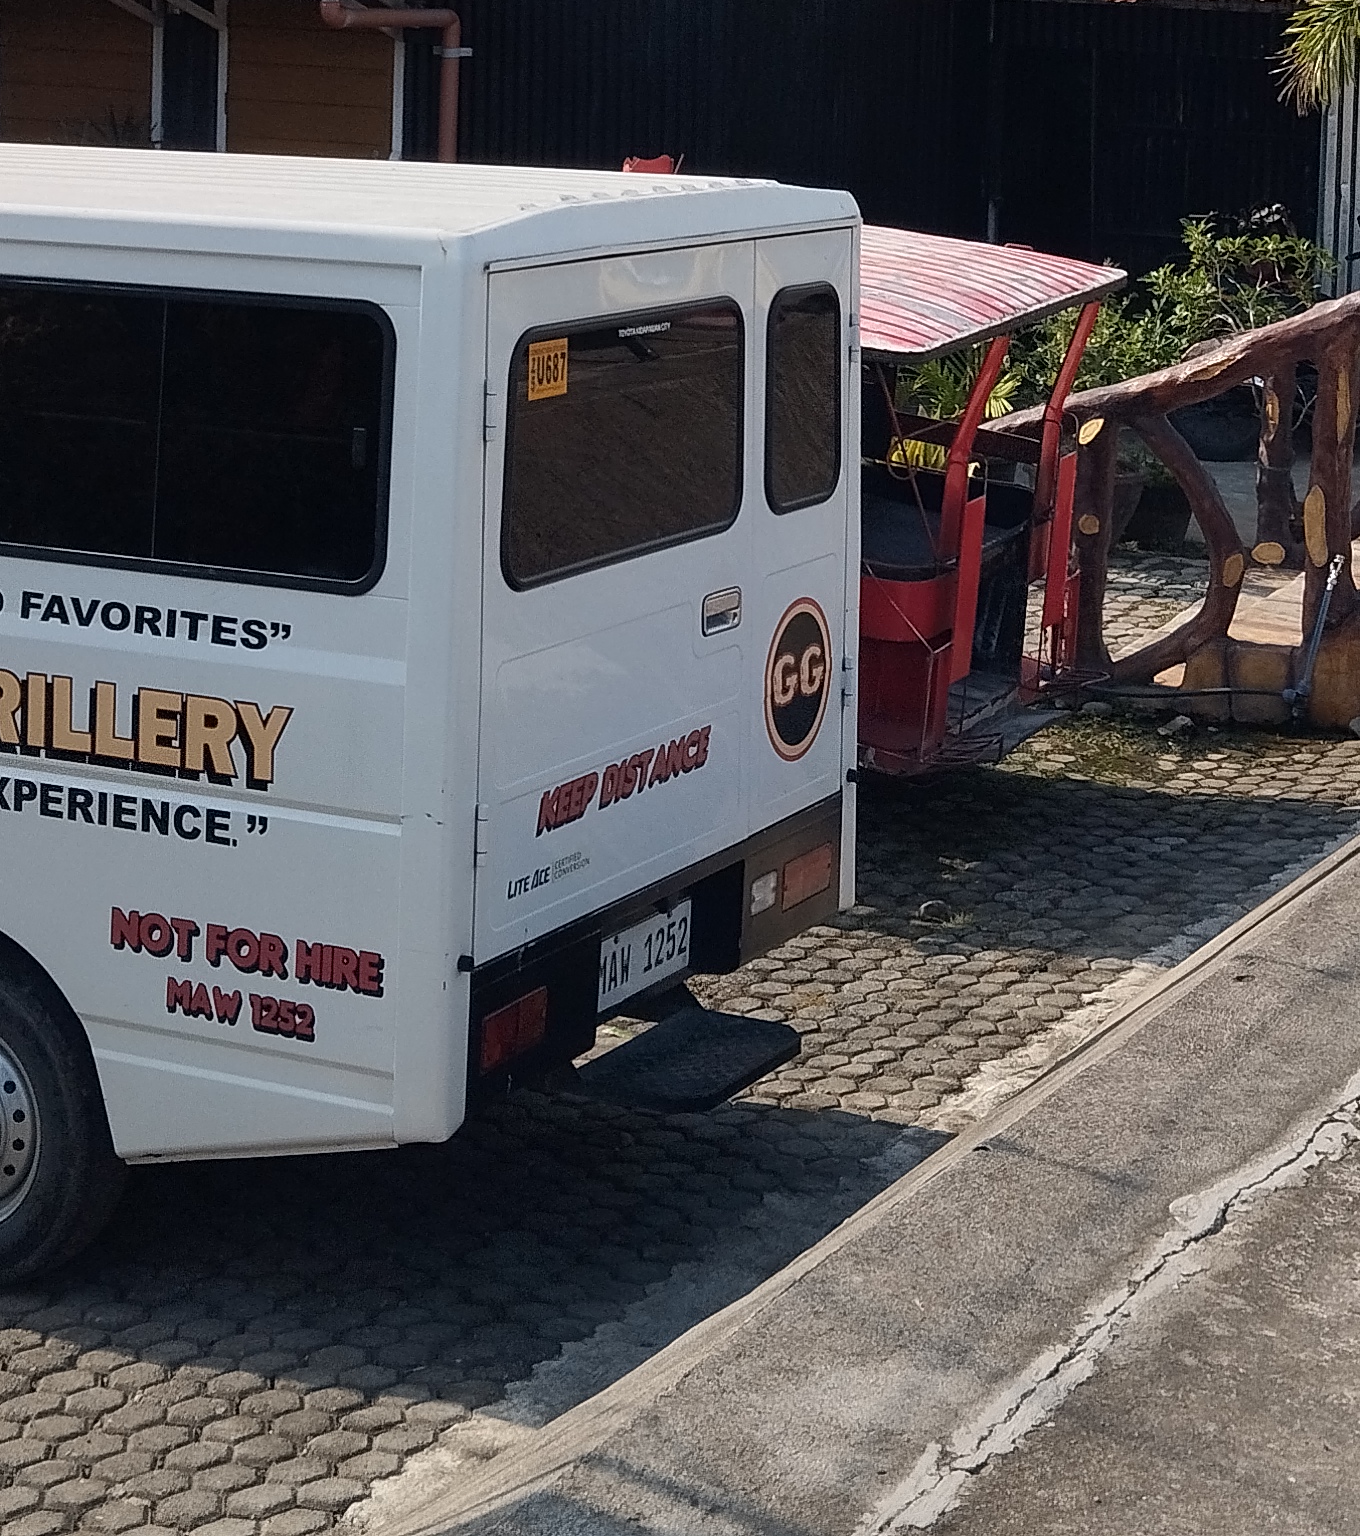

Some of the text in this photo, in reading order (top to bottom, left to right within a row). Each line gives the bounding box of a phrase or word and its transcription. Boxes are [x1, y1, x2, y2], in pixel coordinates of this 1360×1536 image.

[537, 352, 566, 386] U687
[773, 644, 824, 708] GG
[536, 725, 711, 837] KEEP DISTANCE
[507, 875, 530, 900] LITE
[110, 906, 384, 998] NOT FOR HIRE
[643, 916, 688, 973] 1252
[166, 976, 316, 1043] MAW 1252
